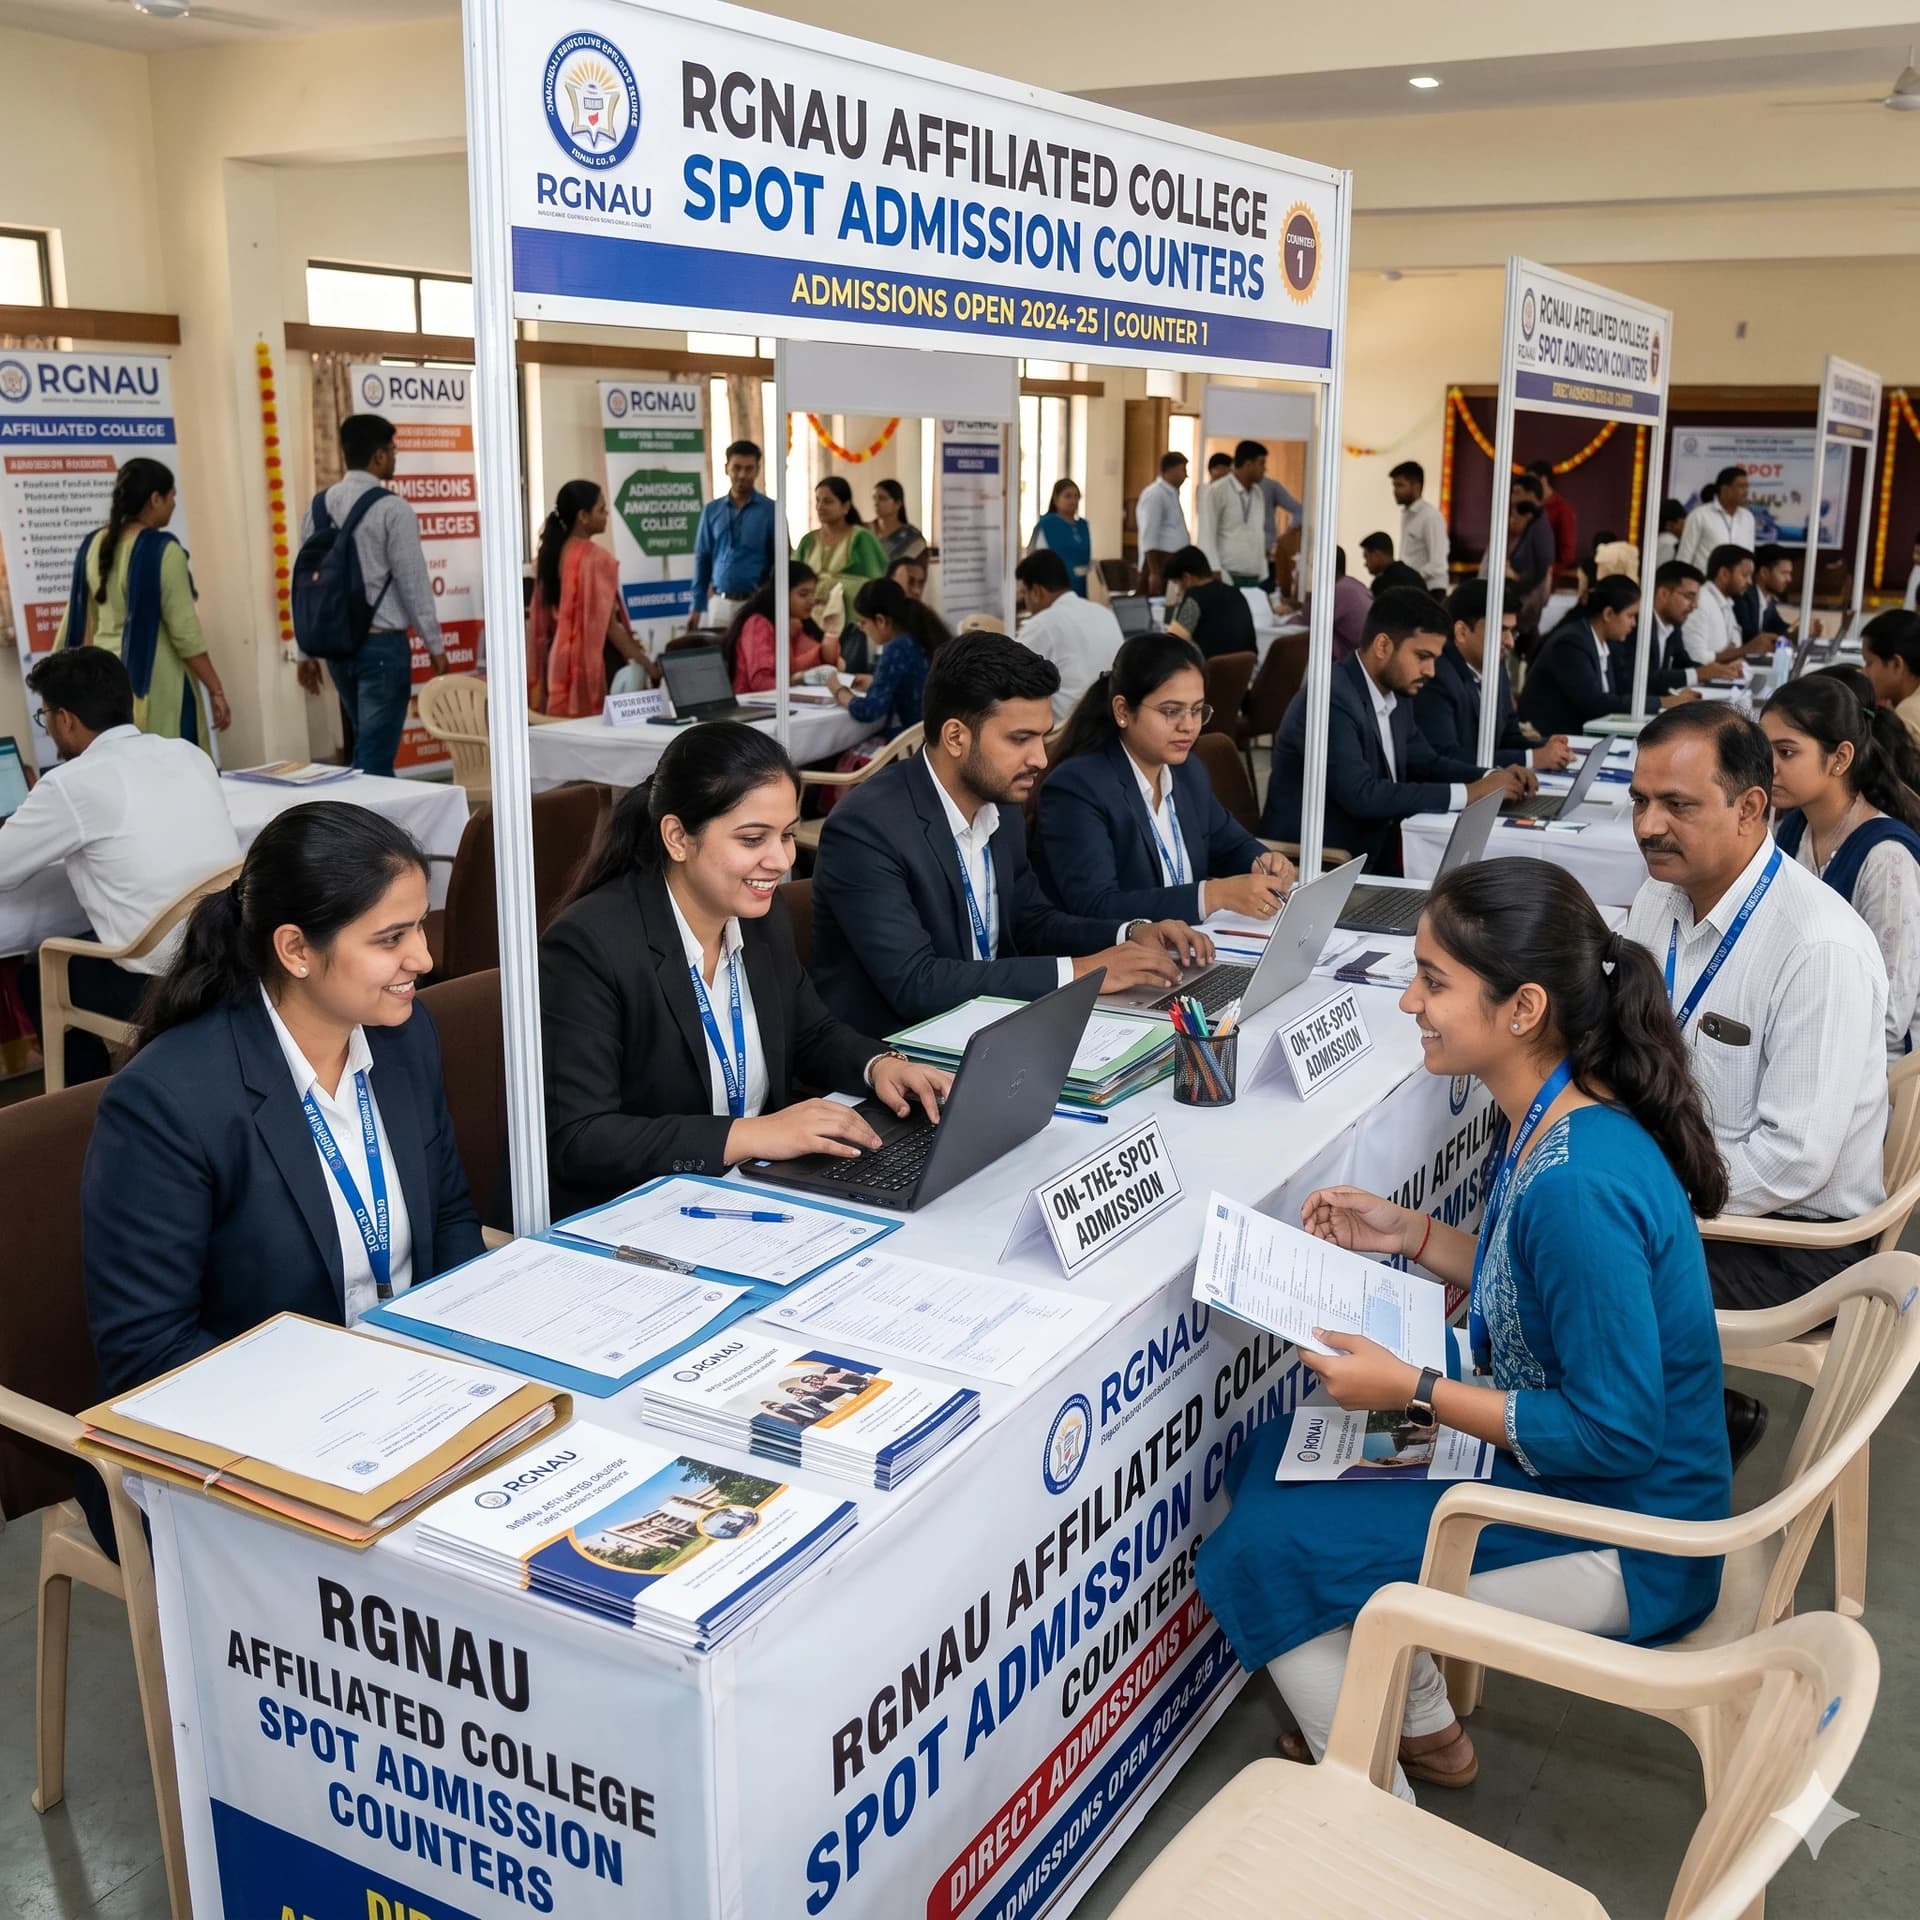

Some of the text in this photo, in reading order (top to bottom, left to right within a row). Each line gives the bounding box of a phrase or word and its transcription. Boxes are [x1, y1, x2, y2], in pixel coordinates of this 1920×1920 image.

[682, 60, 867, 160] RGNAU
[882, 108, 1118, 208] AFFILIATED
[1129, 164, 1268, 239] COLLEGE
[537, 172, 652, 217] RGNAU
[683, 153, 1265, 300] SPOT ADMISSION COUNTERS
[1296, 249, 1304, 279] 1
[791, 273, 1209, 346] ADMISSIONS OPEN 2024-25 COUNTER 1
[1540, 294, 1650, 350] RGNAU AFFILIATED COLLEGE
[37, 363, 159, 395] RGNAU
[389, 377, 465, 401] RGNAU
[1538, 334, 1648, 382] SPOT ADMISSION COUNTERS
[100, 423, 165, 437] COLLEGE
[631, 390, 696, 412] RGNAU
[382, 478, 471, 498] DMISSIONS
[641, 516, 688, 531] COLLEGE
[1291, 996, 1357, 1058] ON-THE-SPOT
[1305, 1025, 1362, 1082] ADMISSION
[1053, 1133, 1160, 1221] ON-THE-SPOT
[1431, 1099, 1497, 1195] AFFILIA
[1075, 1170, 1164, 1250] ADMISSION
[691, 1341, 744, 1371] RGNAU
[1101, 1301, 1210, 1427] RGNAU
[503, 1450, 577, 1492] RGNAU
[832, 1590, 991, 1796] RGNAU
[1006, 1393, 1203, 1629] AFFILIATED
[317, 1576, 530, 1712] RGNAU
[805, 1715, 948, 1917] SPOT
[964, 1470, 1191, 1761] ADMISSION
[227, 1629, 657, 1839] AFFILIATED COLLEGE
[951, 1621, 1180, 1912] DIRECT ADMISSIONS
[1108, 1733, 1149, 1801] OPEN
[258, 1696, 624, 1886] SPOT ADMISSION
[329, 1781, 554, 1913] COUNTERS
